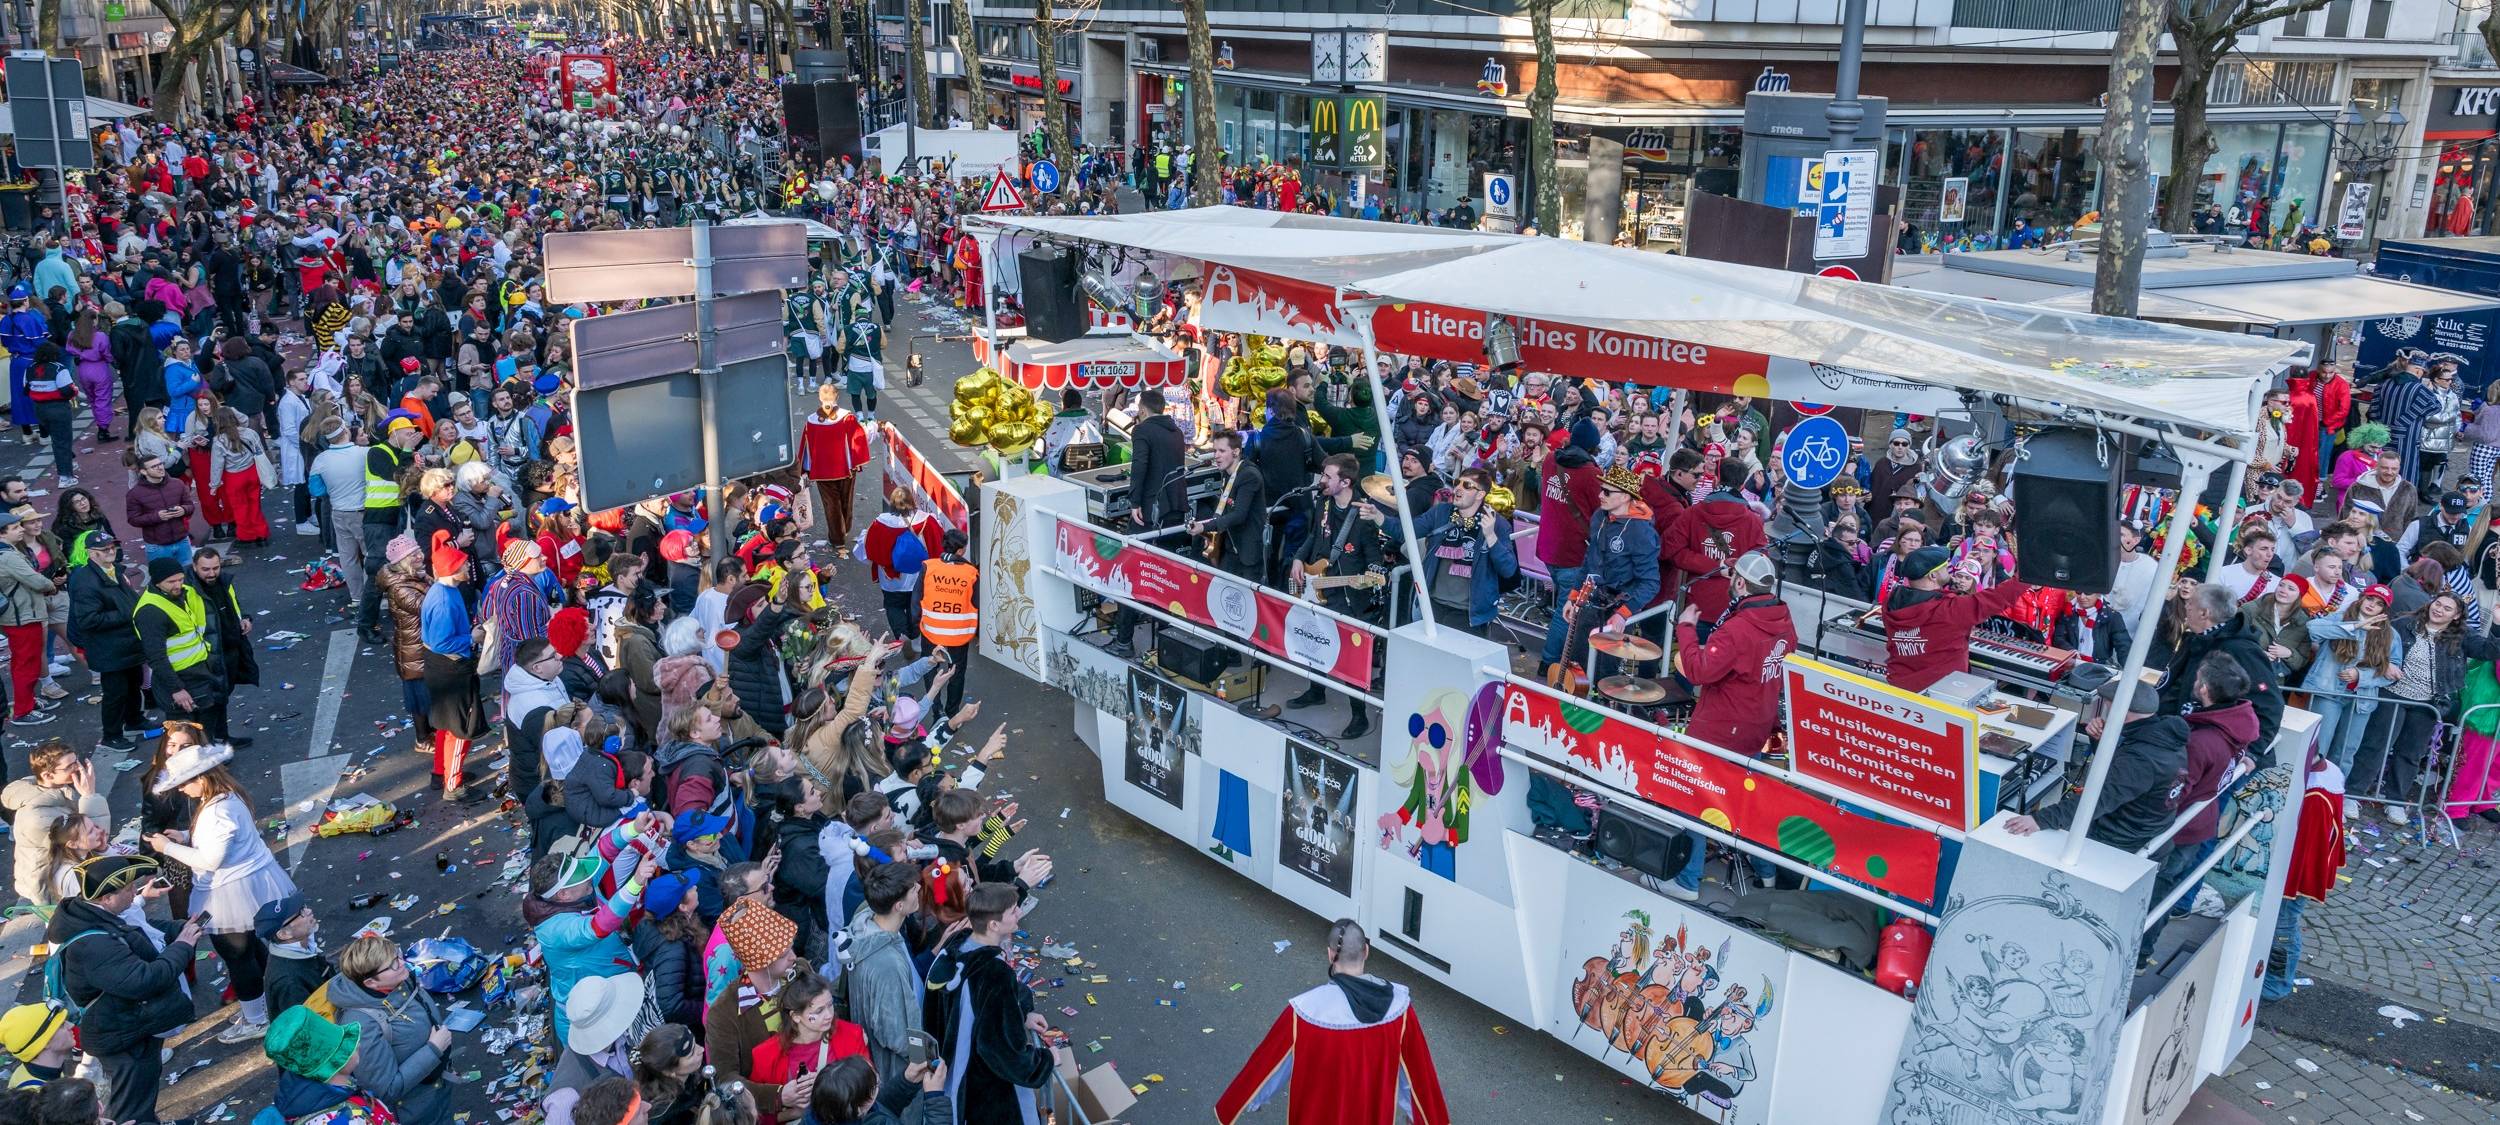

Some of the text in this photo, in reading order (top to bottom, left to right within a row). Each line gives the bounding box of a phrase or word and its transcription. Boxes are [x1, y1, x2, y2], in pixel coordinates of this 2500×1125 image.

[1757, 68, 1789, 91] dm
[2454, 87, 2500, 115] KFC
[1626, 127, 1664, 148] dm
[1349, 154, 1368, 163] METER
[1353, 145, 1365, 155] 50
[1492, 205, 1508, 214] ZONE
[1411, 309, 1709, 366] Literahes Komitee
[1084, 365, 1128, 375] K FK 1062
[2451, 498, 2464, 506] FBI
[2453, 534, 2467, 545] FBI
[1140, 570, 1152, 579] des
[935, 585, 964, 597] Security
[932, 601, 962, 614] 256
[1823, 682, 1925, 723] Gruppe 73
[1819, 708, 1933, 755] Musikwagen
[1137, 745, 1171, 772] GLORIA
[1655, 749, 1703, 774] Preisträger
[1800, 719, 1956, 781] des Literarischen
[1839, 746, 1915, 782] Komitee
[1652, 772, 1694, 796] Komitees:
[1654, 760, 1726, 796] des Literarischen
[1807, 750, 1951, 810] Kölner Karneval
[1295, 826, 1338, 856] GLORIA
[1301, 843, 1331, 865] 26.10.25
